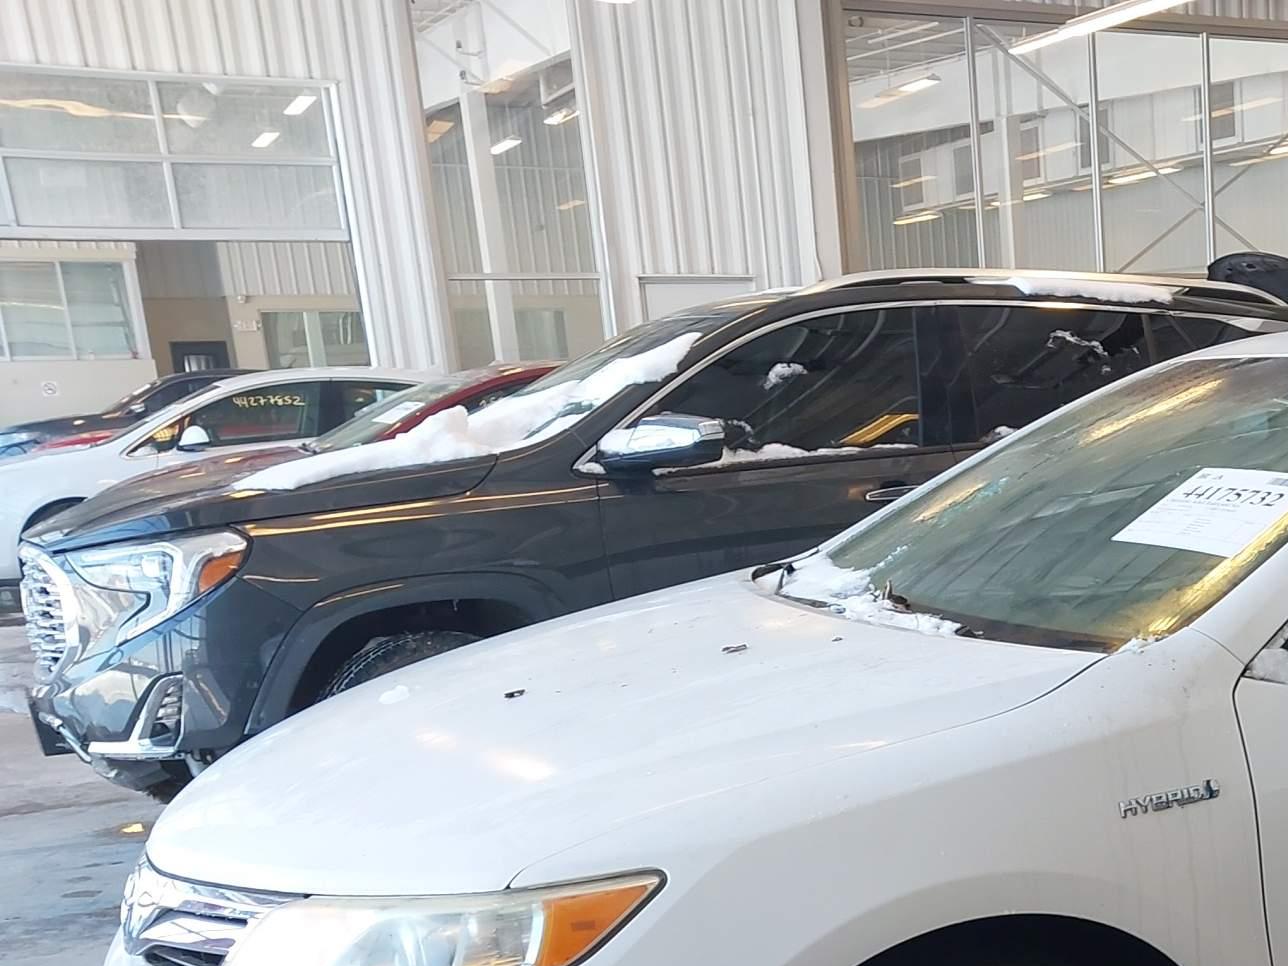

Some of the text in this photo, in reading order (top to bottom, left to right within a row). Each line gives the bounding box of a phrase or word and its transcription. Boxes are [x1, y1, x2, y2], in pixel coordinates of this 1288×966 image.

[232, 395, 306, 408] 44277852
[1182, 485, 1285, 507] 44175732
[1118, 784, 1206, 818] HYBRID
